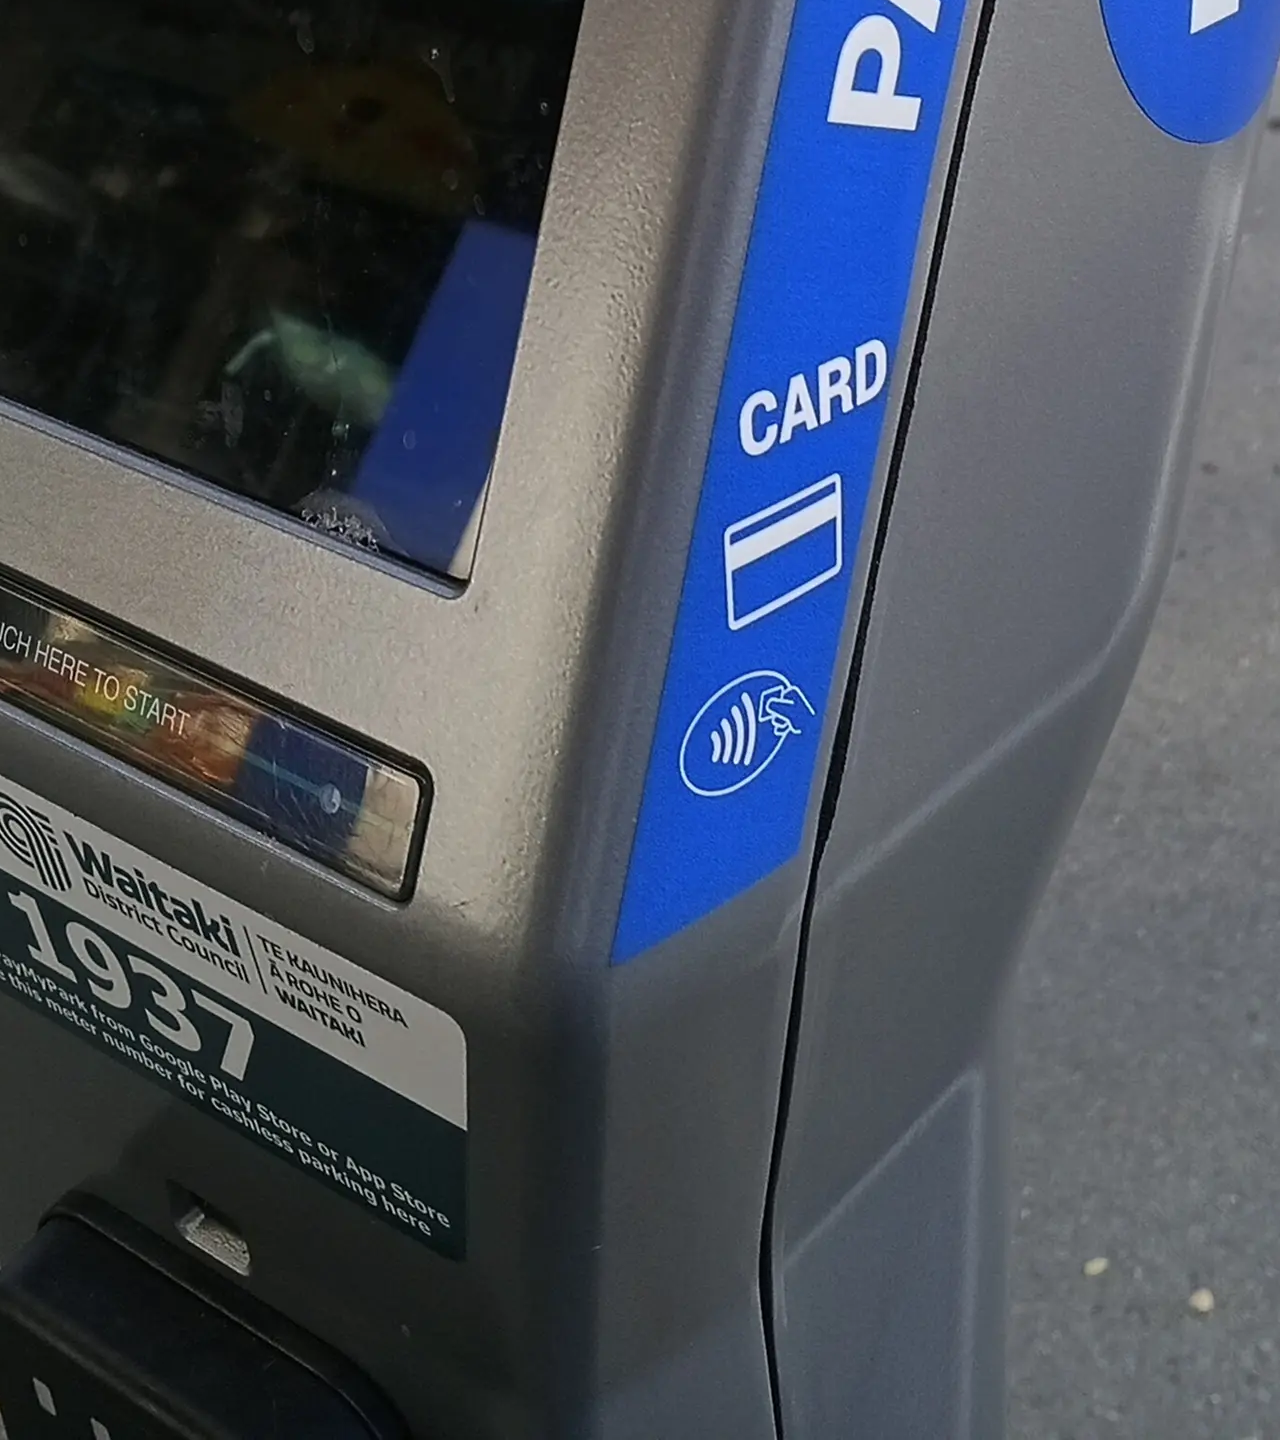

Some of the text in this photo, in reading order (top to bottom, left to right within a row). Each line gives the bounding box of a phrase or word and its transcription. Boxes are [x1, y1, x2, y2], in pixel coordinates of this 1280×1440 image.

[739, 339, 888, 457] CARD
[34, 639, 90, 688] HERE
[94, 667, 120, 701] TO
[123, 685, 191, 736] START
[62, 830, 242, 959] Waitaki
[82, 876, 251, 985] District Council
[8, 891, 256, 1082] 1937
[256, 933, 410, 1030] TE KAUNIHERA
[268, 958, 363, 1024] Ā ROHE O
[274, 985, 367, 1048] WAITAKI
[8, 971, 43, 1003] this
[45, 995, 98, 1036] meter
[101, 1031, 173, 1081] number
[177, 1073, 206, 1101] for
[210, 1096, 295, 1154] cashless
[297, 1147, 378, 1208] parking
[380, 1194, 432, 1237] here
[91, 1004, 136, 1042] from
[139, 1033, 208, 1085] Google
[209, 1074, 252, 1113] Play
[256, 1103, 314, 1148] Store
[317, 1141, 340, 1162] or
[346, 1155, 387, 1191] App
[390, 1181, 452, 1229] Store
